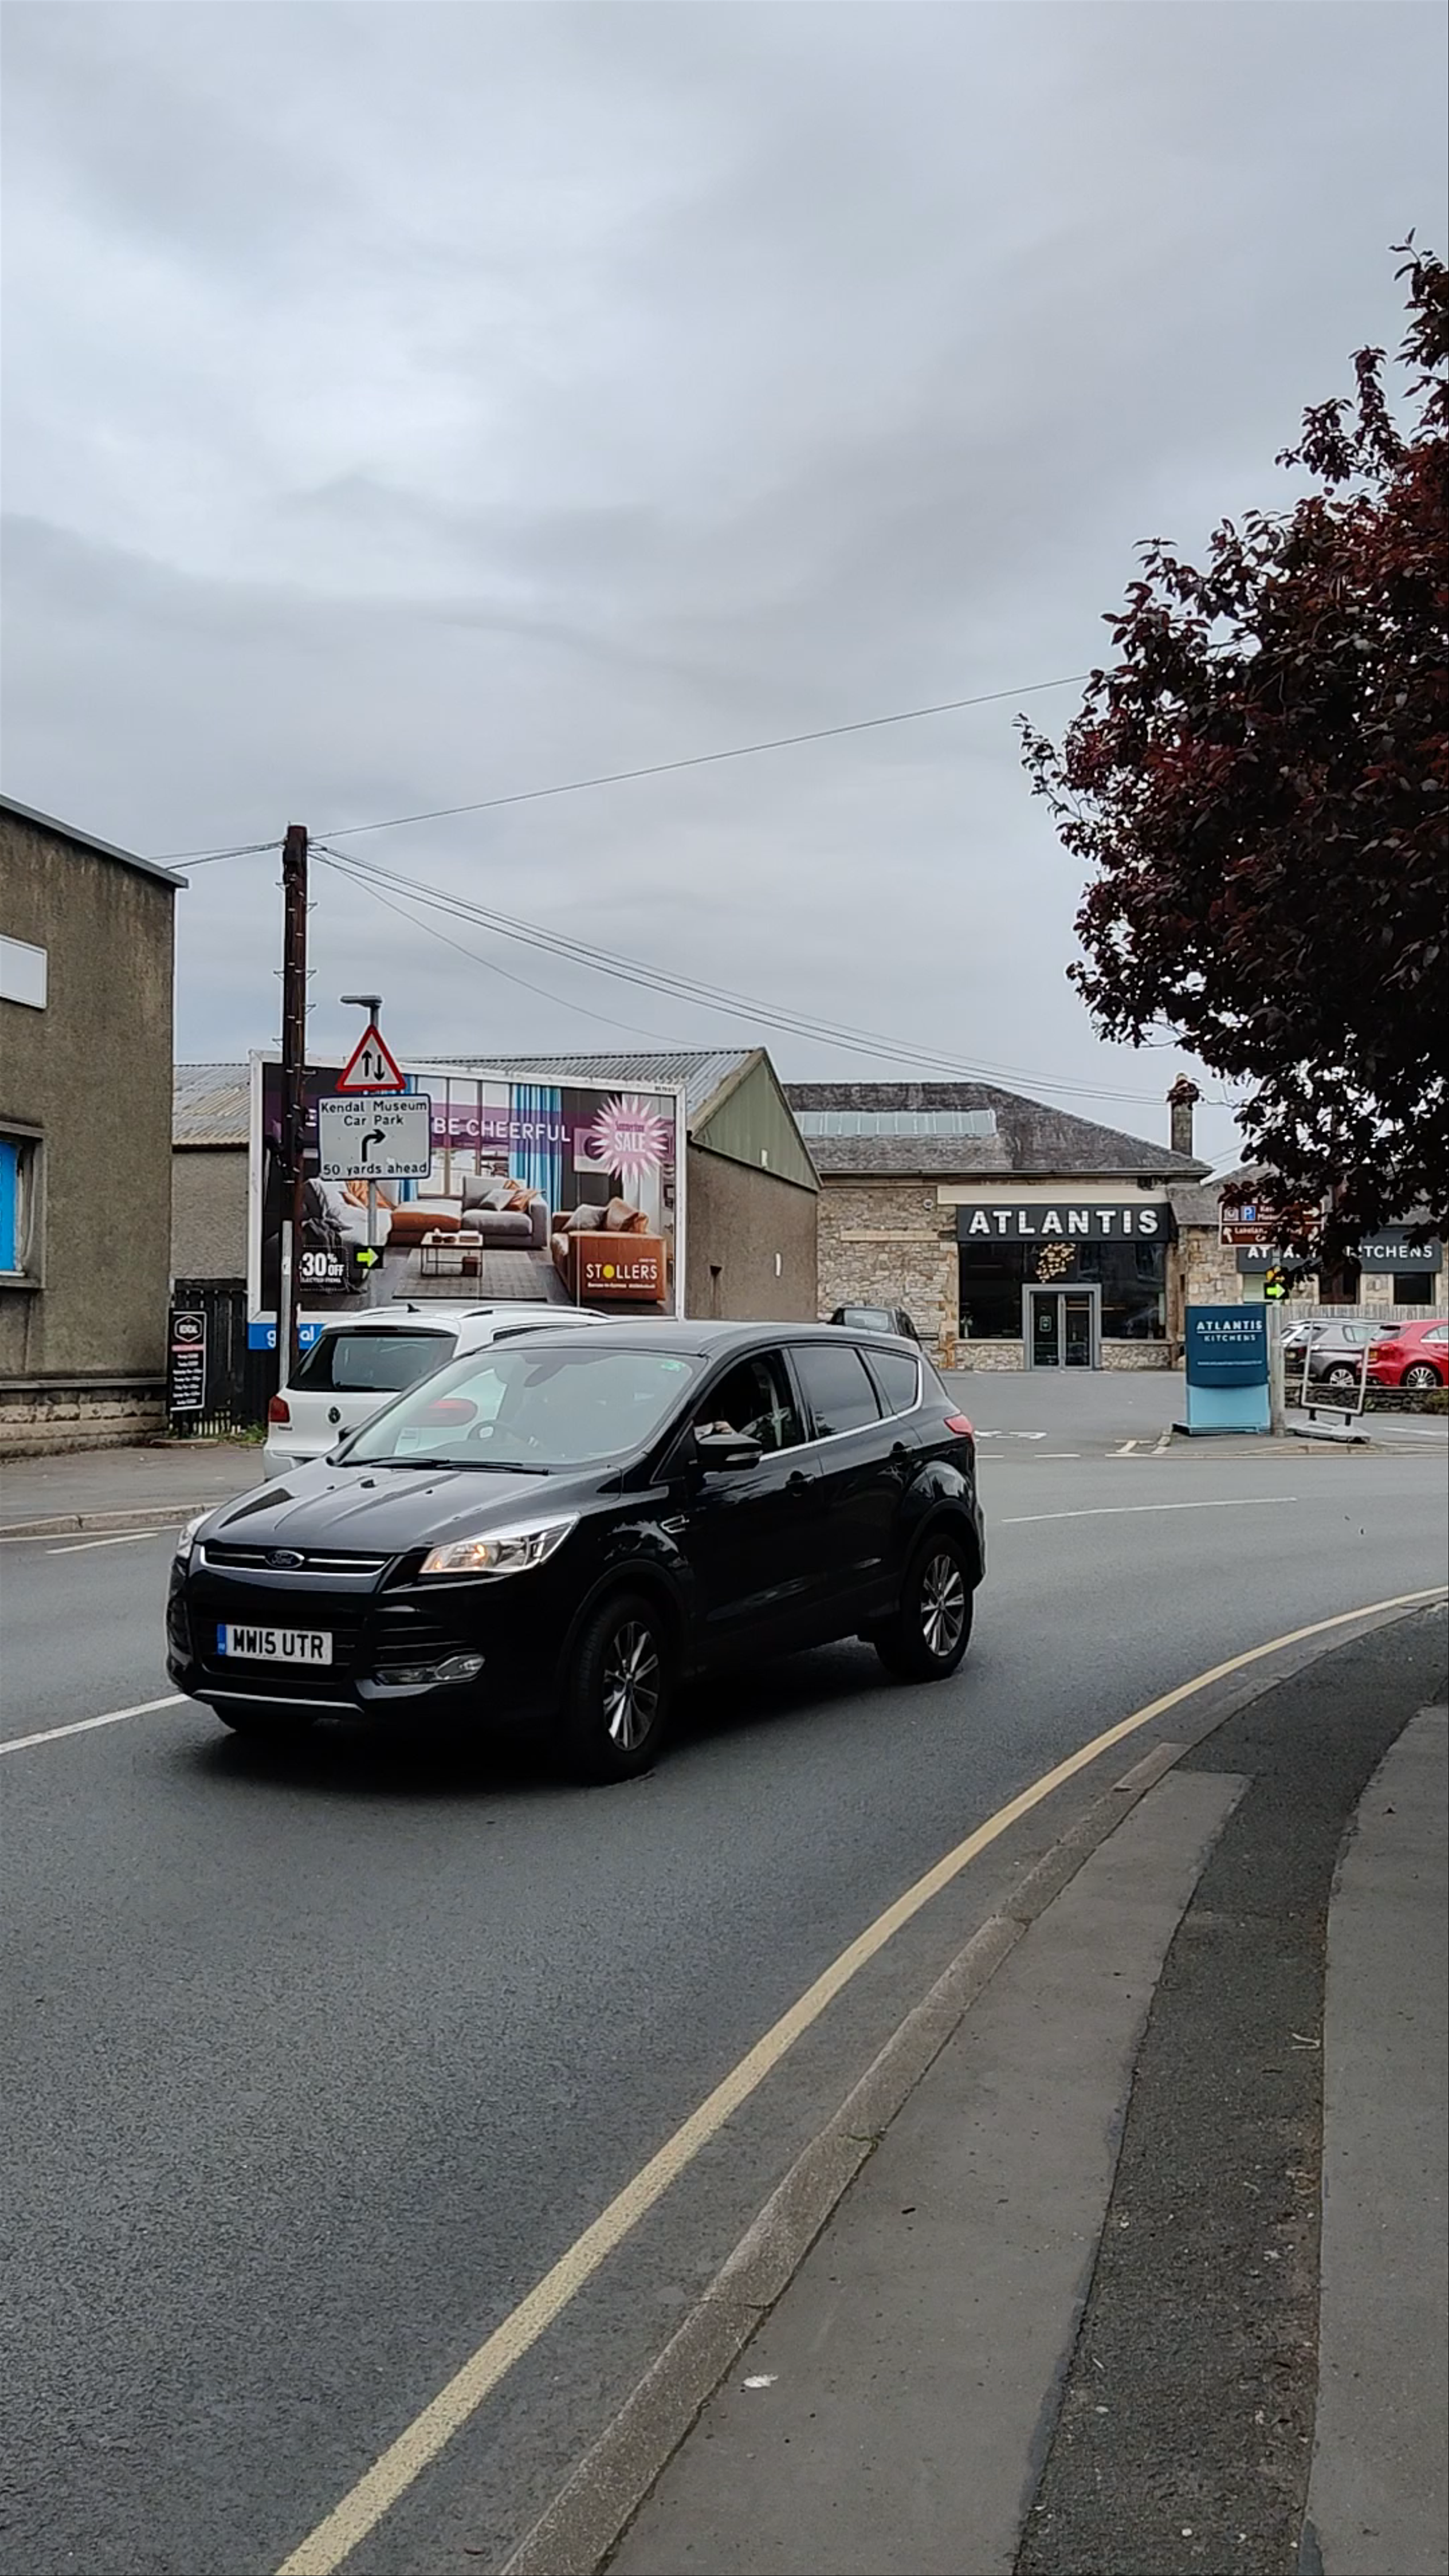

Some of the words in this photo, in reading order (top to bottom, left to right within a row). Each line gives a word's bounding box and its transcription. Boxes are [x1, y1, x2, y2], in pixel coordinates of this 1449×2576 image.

[321, 1101, 365, 1113] Kendal
[374, 1101, 427, 1112] Museum
[344, 1115, 366, 1126] Car
[374, 1115, 404, 1125] Park
[433, 1118, 460, 1135] BE
[466, 1119, 571, 1142] CHEERFUL
[614, 1132, 646, 1153] SALE
[323, 1164, 340, 1175] 50
[347, 1164, 382, 1176] yards
[388, 1162, 427, 1174] ahead
[969, 1210, 1158, 1234] ATLANTIS
[328, 1264, 344, 1276] OFF
[586, 1264, 658, 1280] STOLLERS
[1196, 1320, 1263, 1330] ATLANTIS
[271, 1554, 294, 1564] Ford
[234, 1628, 277, 1654] MW15
[283, 1633, 323, 1659] UTR
